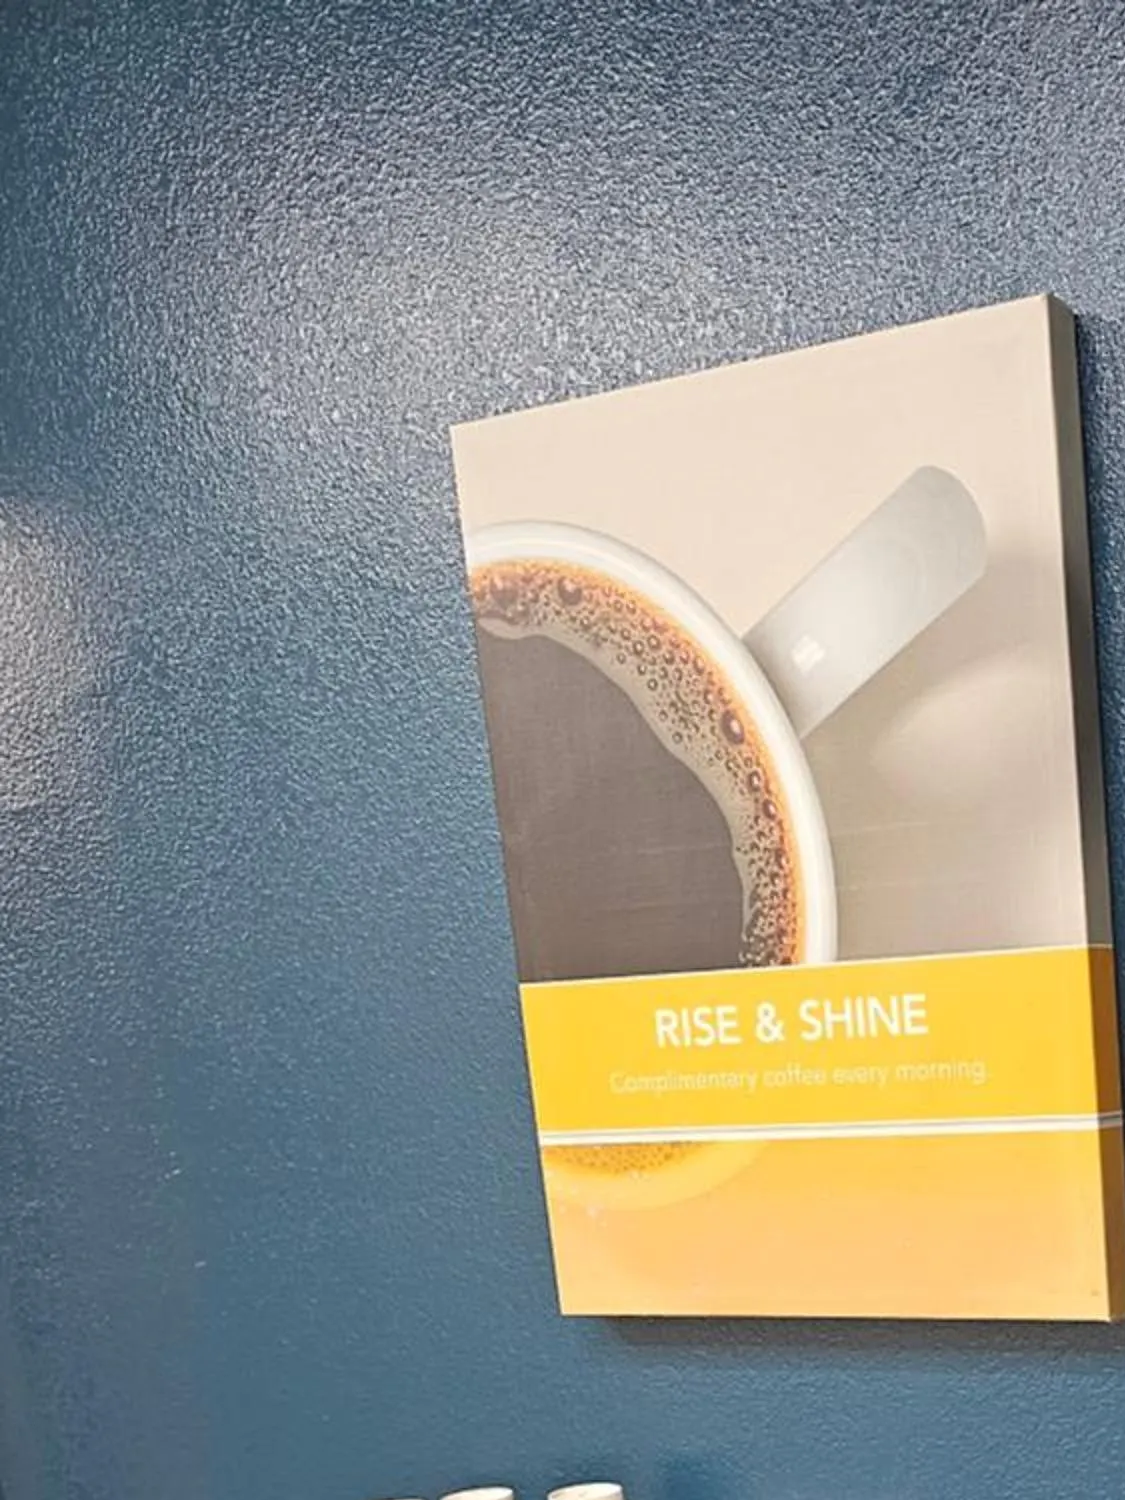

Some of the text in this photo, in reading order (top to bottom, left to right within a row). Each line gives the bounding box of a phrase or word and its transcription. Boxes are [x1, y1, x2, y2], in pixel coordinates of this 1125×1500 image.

[654, 993, 929, 1049] RISE & SHINE
[609, 1071, 757, 1096] Complimentary
[763, 1062, 826, 1088] coffee
[832, 1064, 888, 1088] every
